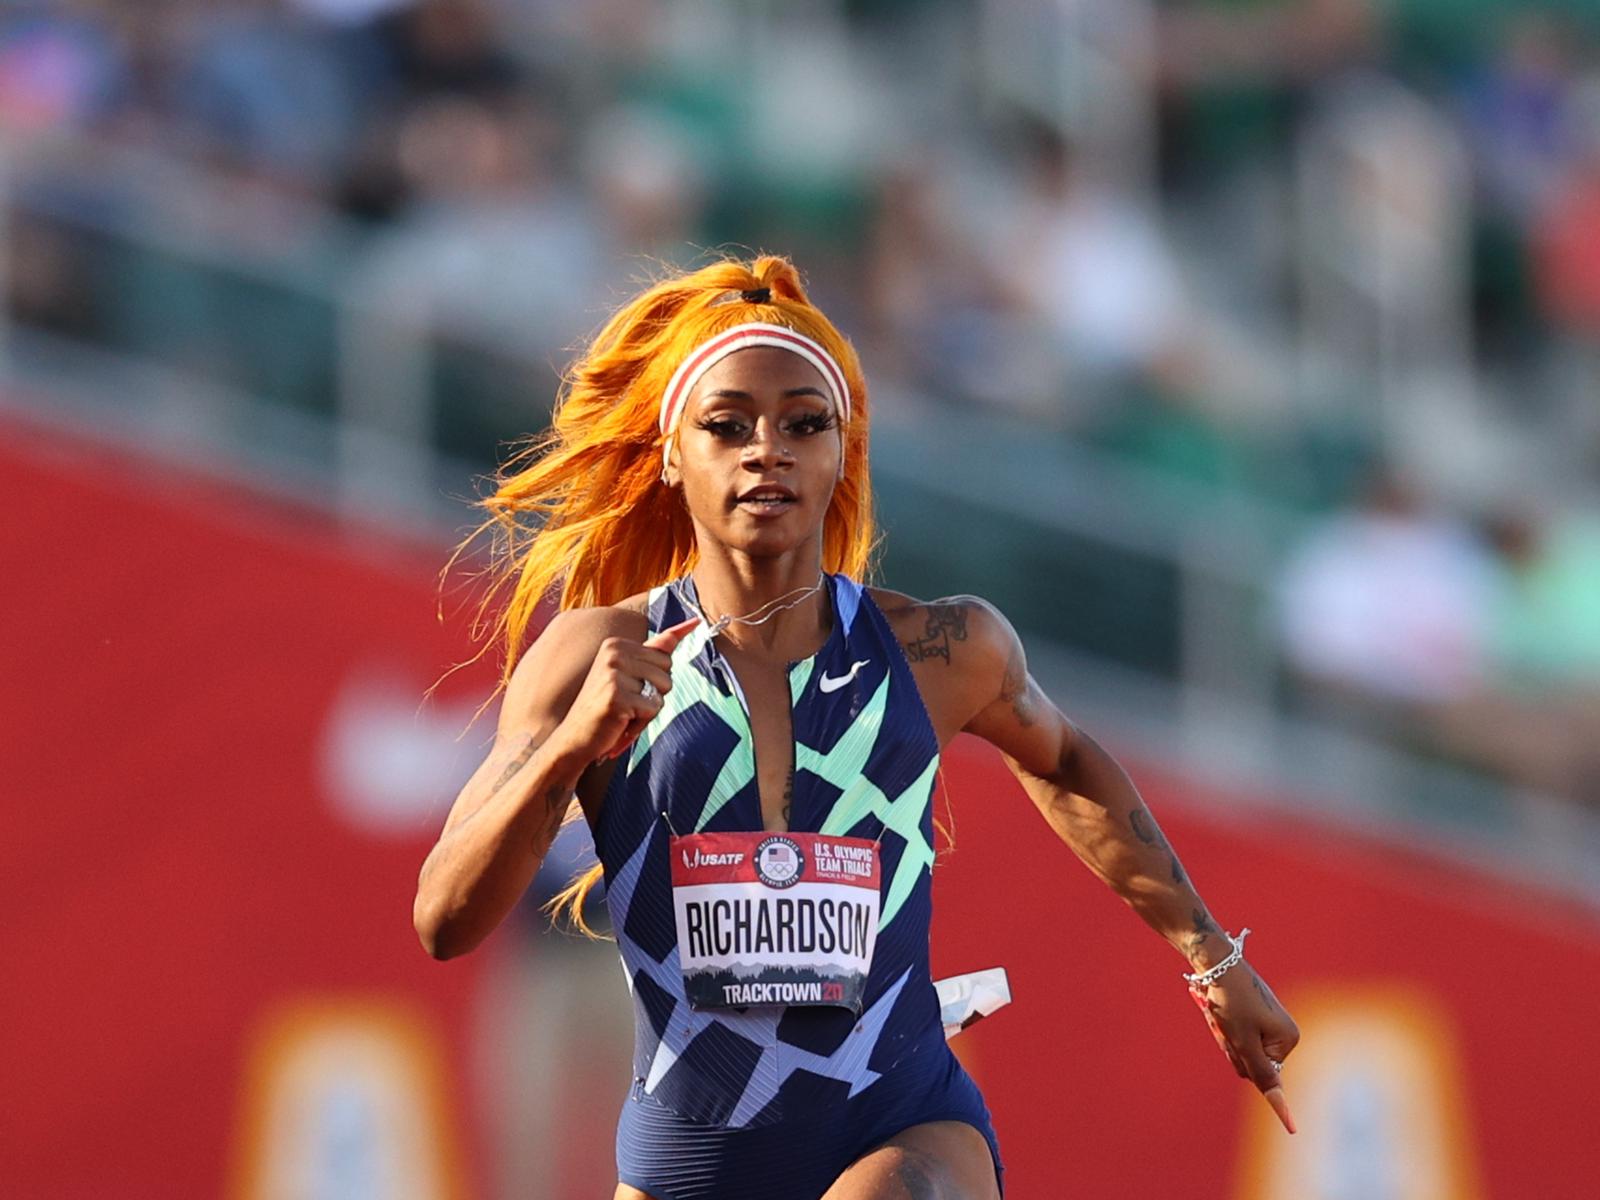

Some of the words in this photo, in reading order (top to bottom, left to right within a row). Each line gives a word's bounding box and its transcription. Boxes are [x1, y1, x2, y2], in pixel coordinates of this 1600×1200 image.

[700, 853, 744, 866] USATF
[814, 842, 833, 858] U.S.
[833, 844, 873, 862] OLYMPIC
[815, 857, 841, 873] TEAM
[842, 859, 872, 878] TRIALS
[685, 898, 870, 959] RICHARDSON
[723, 982, 822, 1004] TRACKTOWN
